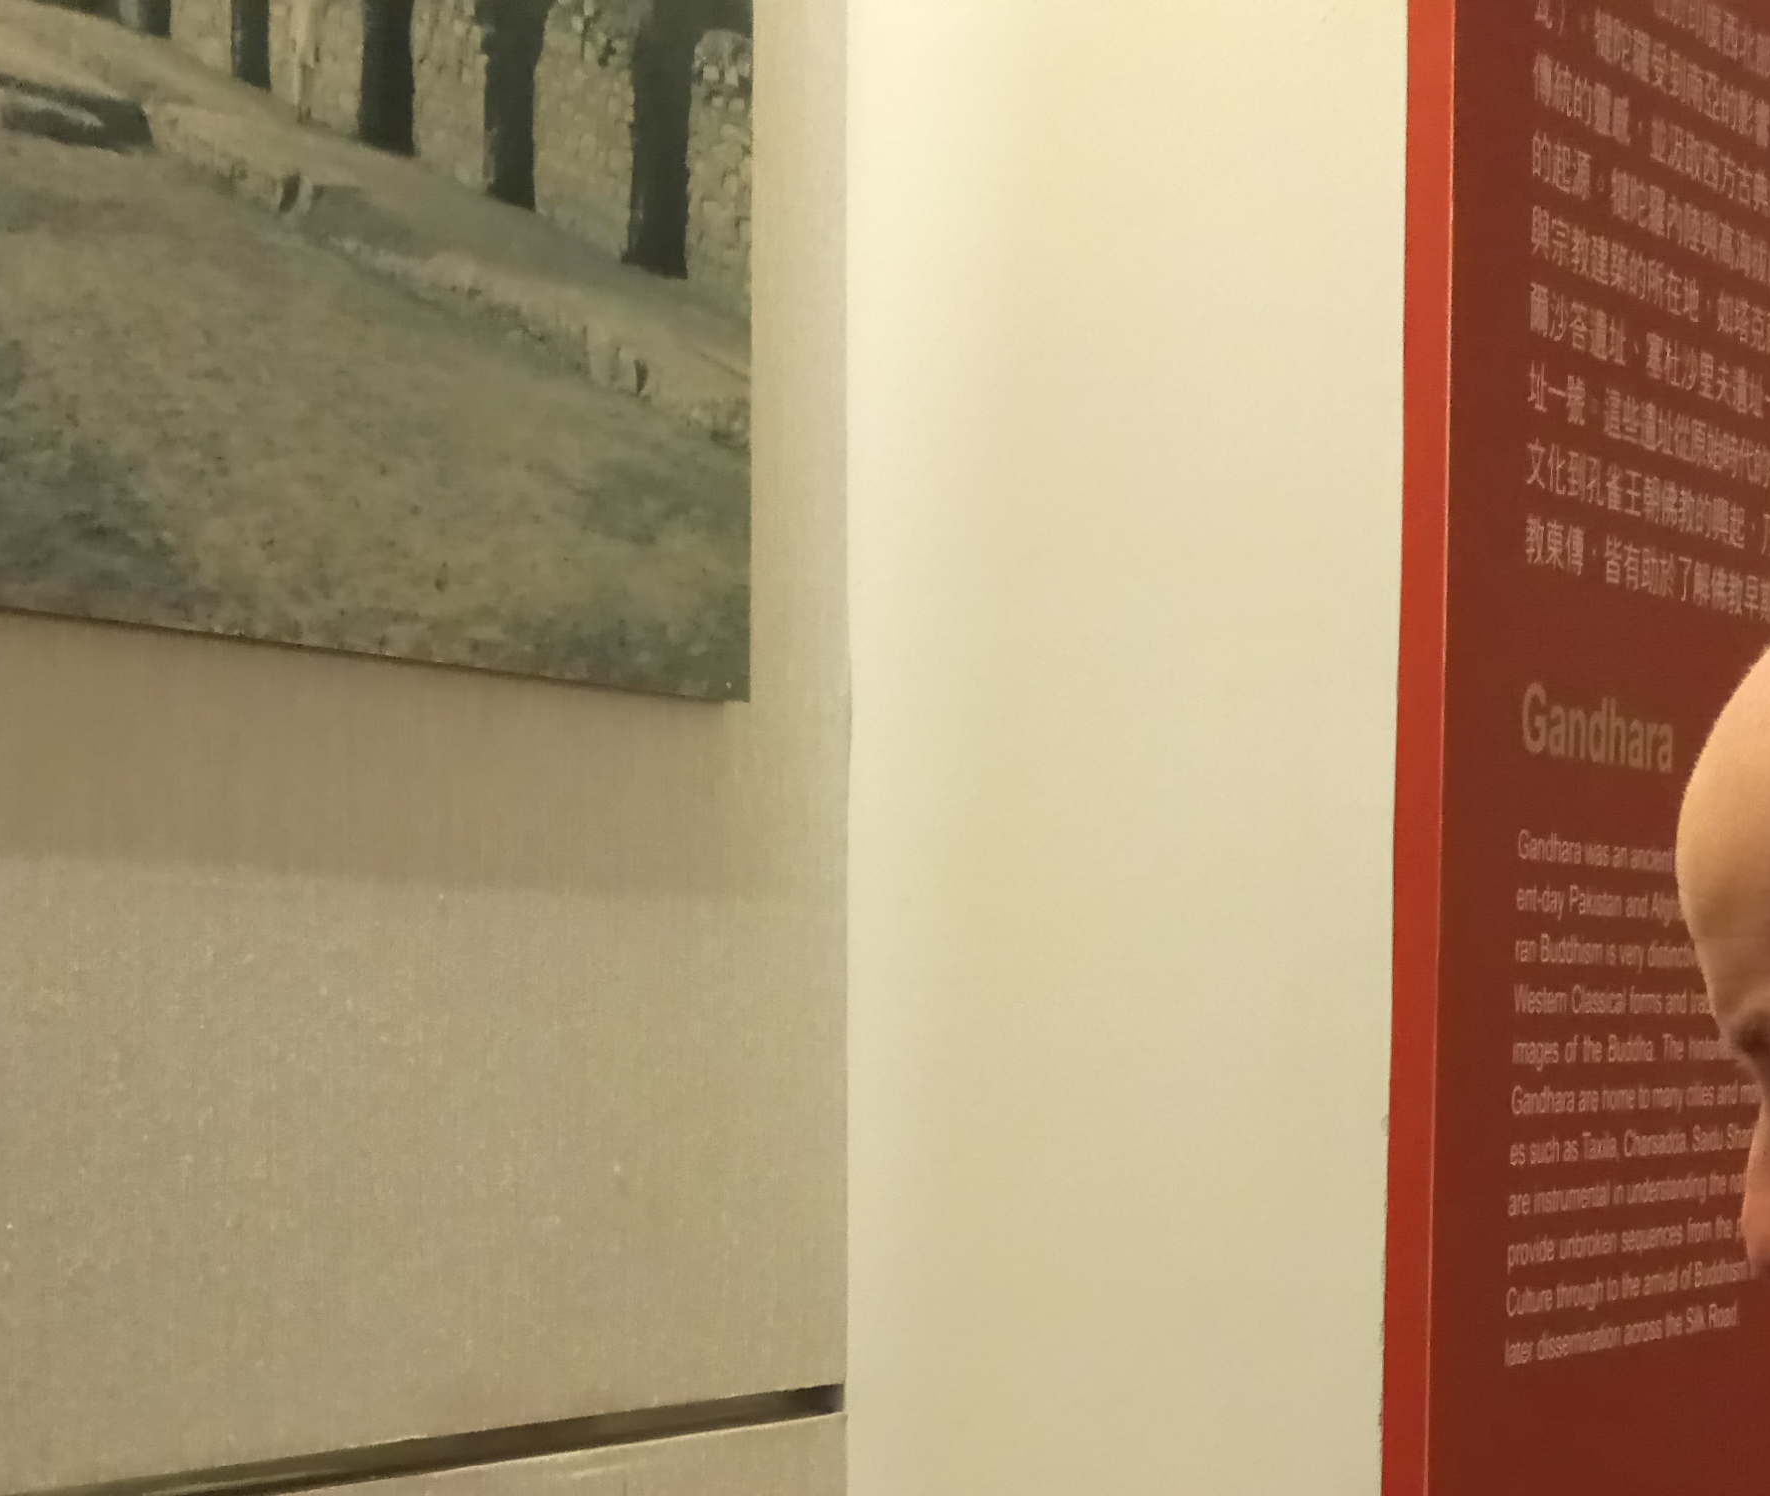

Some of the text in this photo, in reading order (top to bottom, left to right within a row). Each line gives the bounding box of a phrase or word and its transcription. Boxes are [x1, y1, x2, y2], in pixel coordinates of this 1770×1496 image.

[1521, 681, 1673, 773] Gandhara
[1517, 829, 1582, 864] Gandhara
[1584, 844, 1610, 867] was
[1613, 846, 1628, 868] an
[1516, 885, 1565, 921] ent-day
[1569, 884, 1622, 917] Pakistan
[1625, 891, 1648, 918] and
[1515, 939, 1536, 962] ran
[1540, 933, 1603, 965] Buddhism
[1606, 941, 1616, 965] is
[1619, 944, 1644, 974] very
[1514, 984, 1567, 1014] Western
[1572, 984, 1625, 1014] Classical
[1629, 986, 1662, 1014] forms
[1665, 988, 1686, 1014] and
[1512, 1040, 1559, 1072] images
[1564, 1034, 1578, 1063] of
[1583, 1034, 1603, 1062] the
[1663, 1033, 1684, 1060] The
[1511, 1085, 1575, 1115] Gandhara
[1578, 1089, 1599, 1113] are
[1602, 1083, 1635, 1110] home
[1638, 1083, 1649, 1109] to
[1652, 1086, 1683, 1114] many
[1686, 1081, 1714, 1106] cities
[1717, 1079, 1738, 1105] and
[1509, 1142, 1525, 1166] es
[1529, 1135, 1559, 1165] such
[1563, 1140, 1578, 1162] as
[1727, 1122, 1754, 1150] Shar
[1508, 1193, 1530, 1217] are
[1533, 1179, 1610, 1214] instrumental
[1613, 1182, 1624, 1205] in
[1627, 1171, 1706, 1204] understanding
[1709, 1167, 1727, 1195] the
[1507, 1234, 1554, 1275] provide
[1559, 1228, 1617, 1260] unbroken
[1621, 1224, 1683, 1257] sequences
[1687, 1216, 1711, 1243] from
[1715, 1214, 1732, 1239] the
[1506, 1286, 1553, 1317] Culture
[1556, 1275, 1603, 1311] through
[1606, 1277, 1618, 1301] to
[1622, 1271, 1640, 1299] the
[1644, 1265, 1678, 1296] arrival
[1681, 1261, 1692, 1290] of
[1694, 1258, 1747, 1288] Buddhism
[1504, 1340, 1534, 1366] later
[1537, 1322, 1621, 1360] dissemination
[1624, 1319, 1662, 1346] across
[1666, 1311, 1682, 1338] the
[1686, 1305, 1705, 1334] Silk
